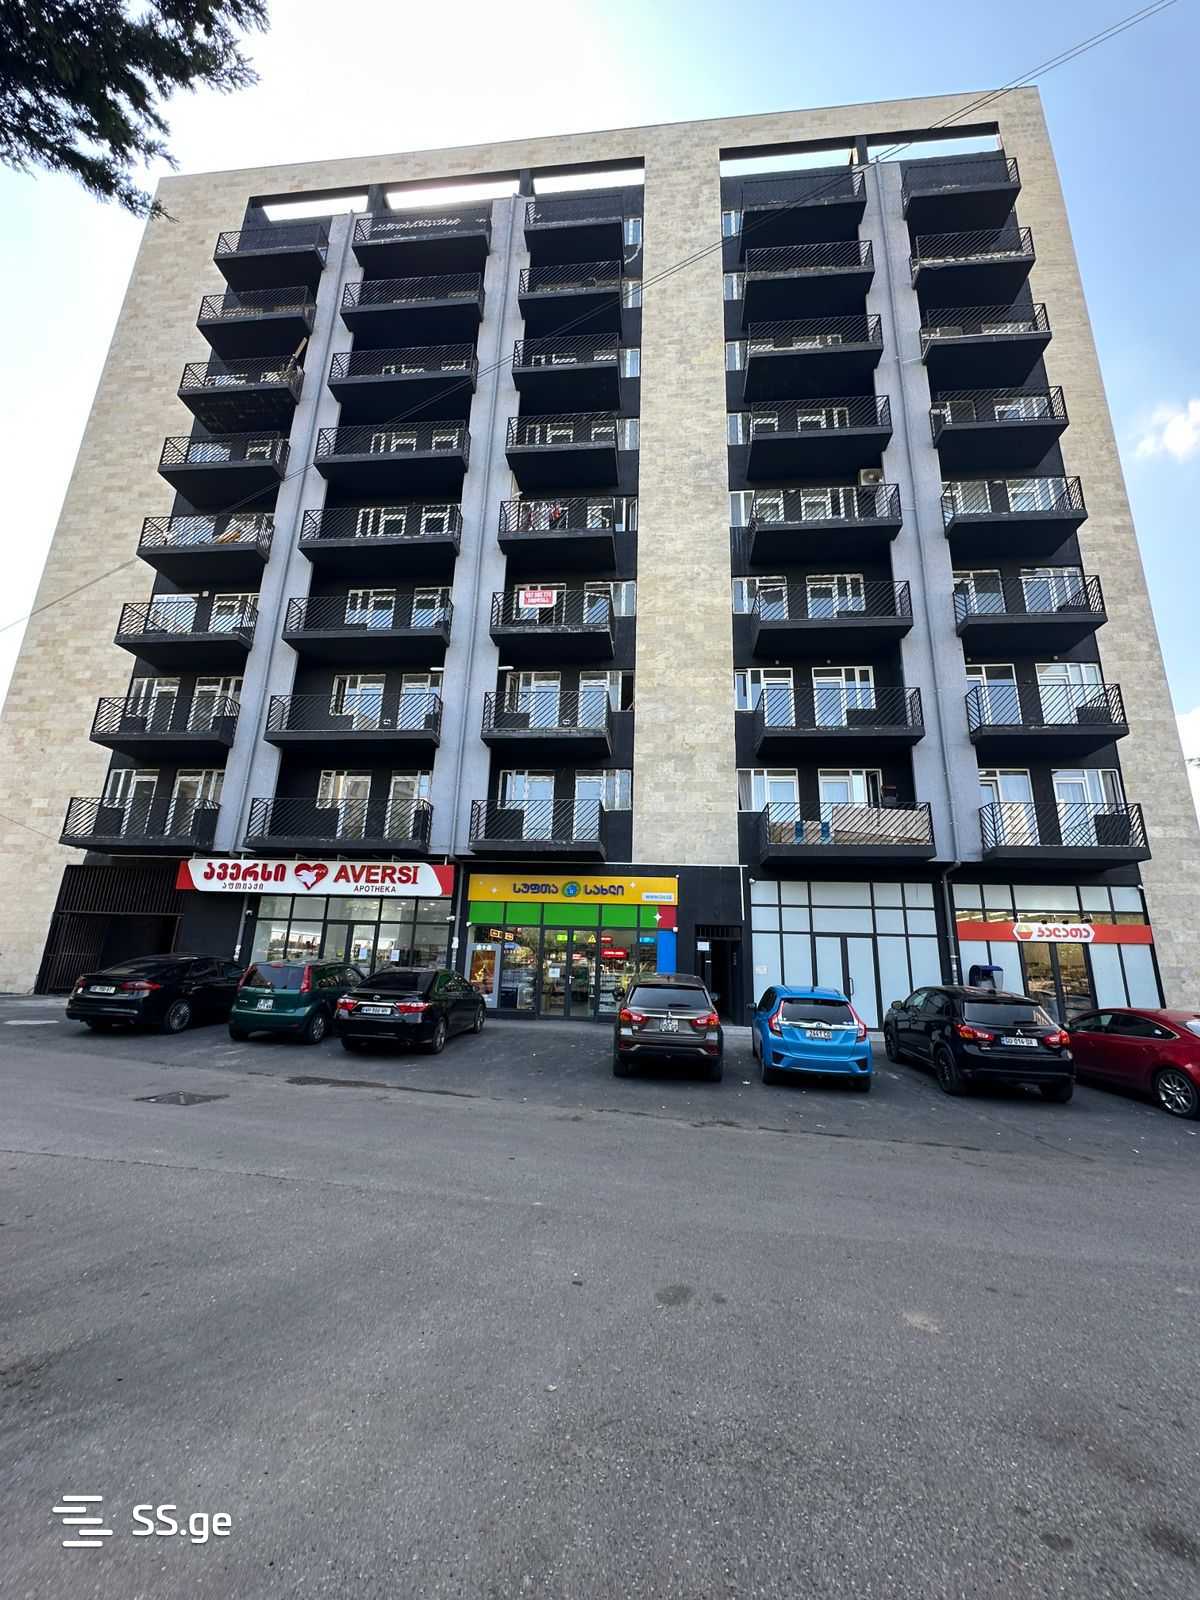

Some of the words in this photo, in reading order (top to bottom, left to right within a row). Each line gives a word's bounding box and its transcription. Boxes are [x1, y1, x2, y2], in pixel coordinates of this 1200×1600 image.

[203, 862, 287, 882] ავერსი
[333, 864, 420, 885] AVERSI
[353, 885, 396, 893] APOTHEKA
[512, 882, 559, 894] სუფთა
[584, 884, 624, 896] სახლი
